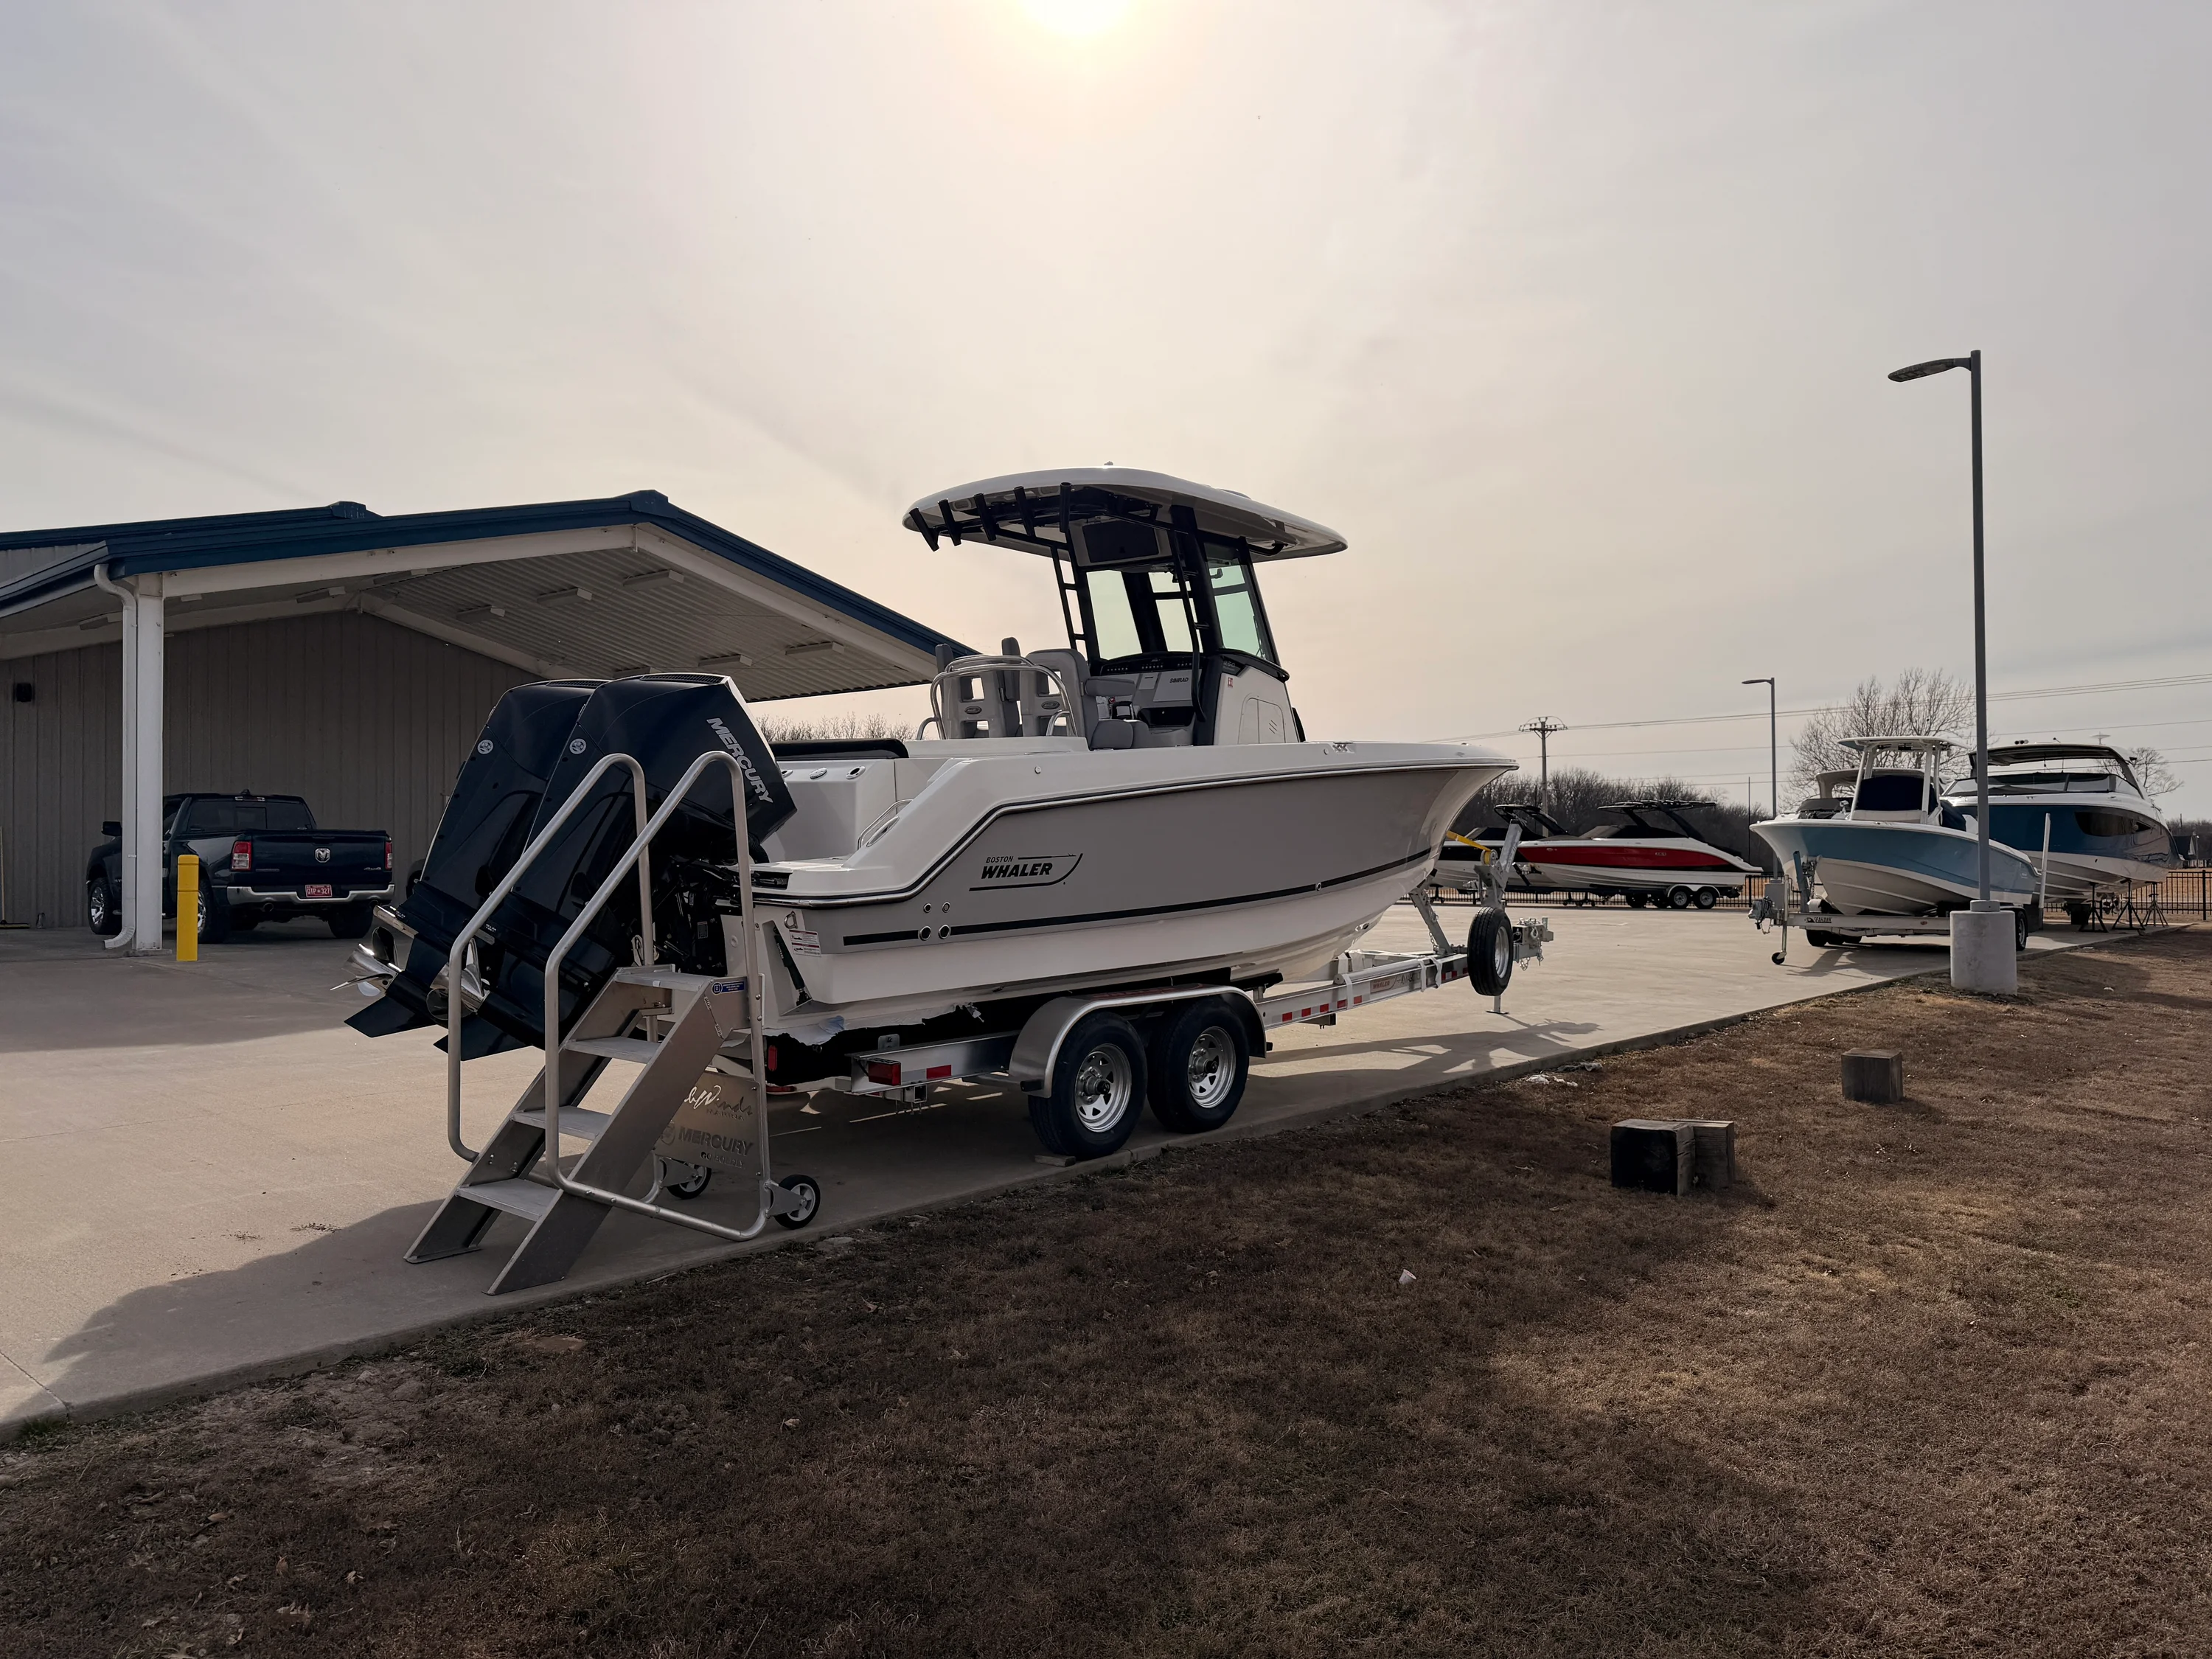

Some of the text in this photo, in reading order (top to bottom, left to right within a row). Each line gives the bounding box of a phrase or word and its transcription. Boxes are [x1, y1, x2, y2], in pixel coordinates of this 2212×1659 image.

[706, 717, 773, 803] MERCURY
[981, 863, 1053, 879] WHALER
[678, 1126, 754, 1156] MERCURY
